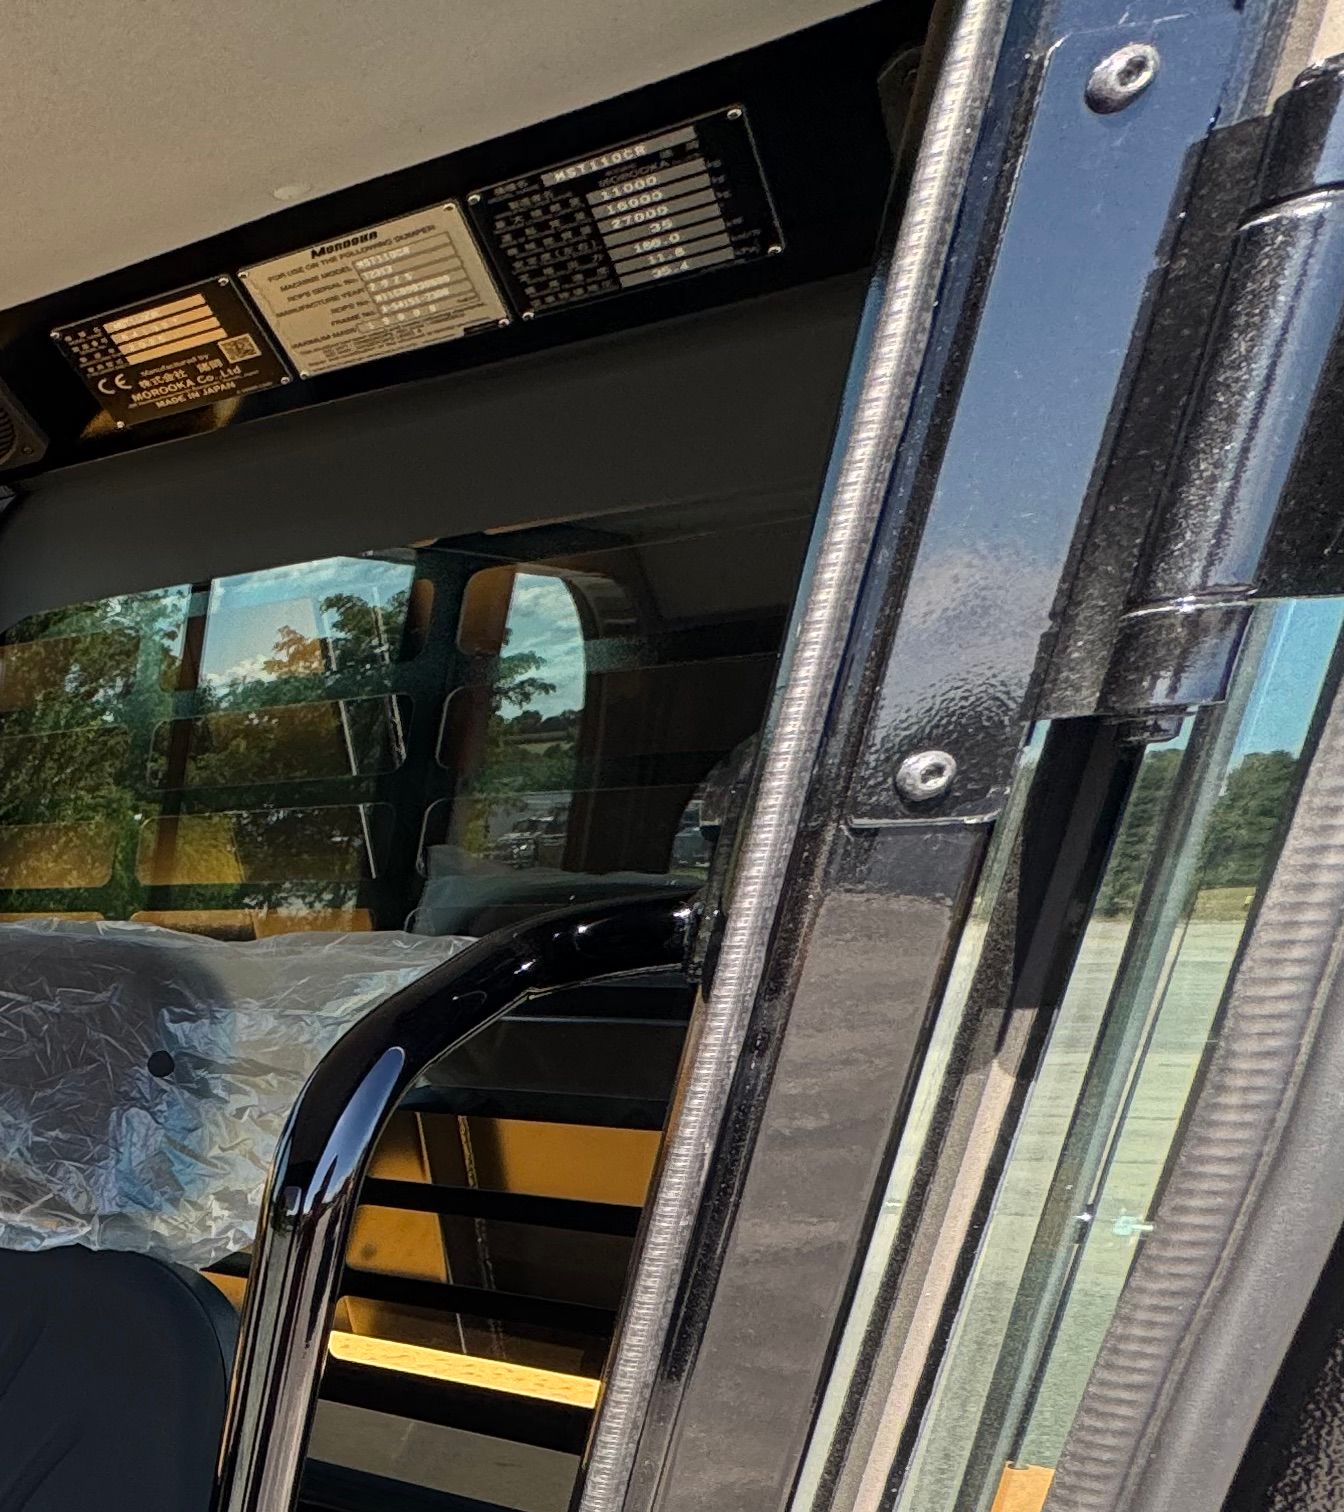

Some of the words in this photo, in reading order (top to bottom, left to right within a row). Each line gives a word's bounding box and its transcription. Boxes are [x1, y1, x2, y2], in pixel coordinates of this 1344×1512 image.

[552, 144, 647, 182] MST110CR
[599, 175, 657, 199] 11000
[130, 378, 195, 402] MOROOKA
[154, 395, 186, 407] MADE
[186, 391, 200, 399] IN
[200, 381, 236, 395] JAPAN
